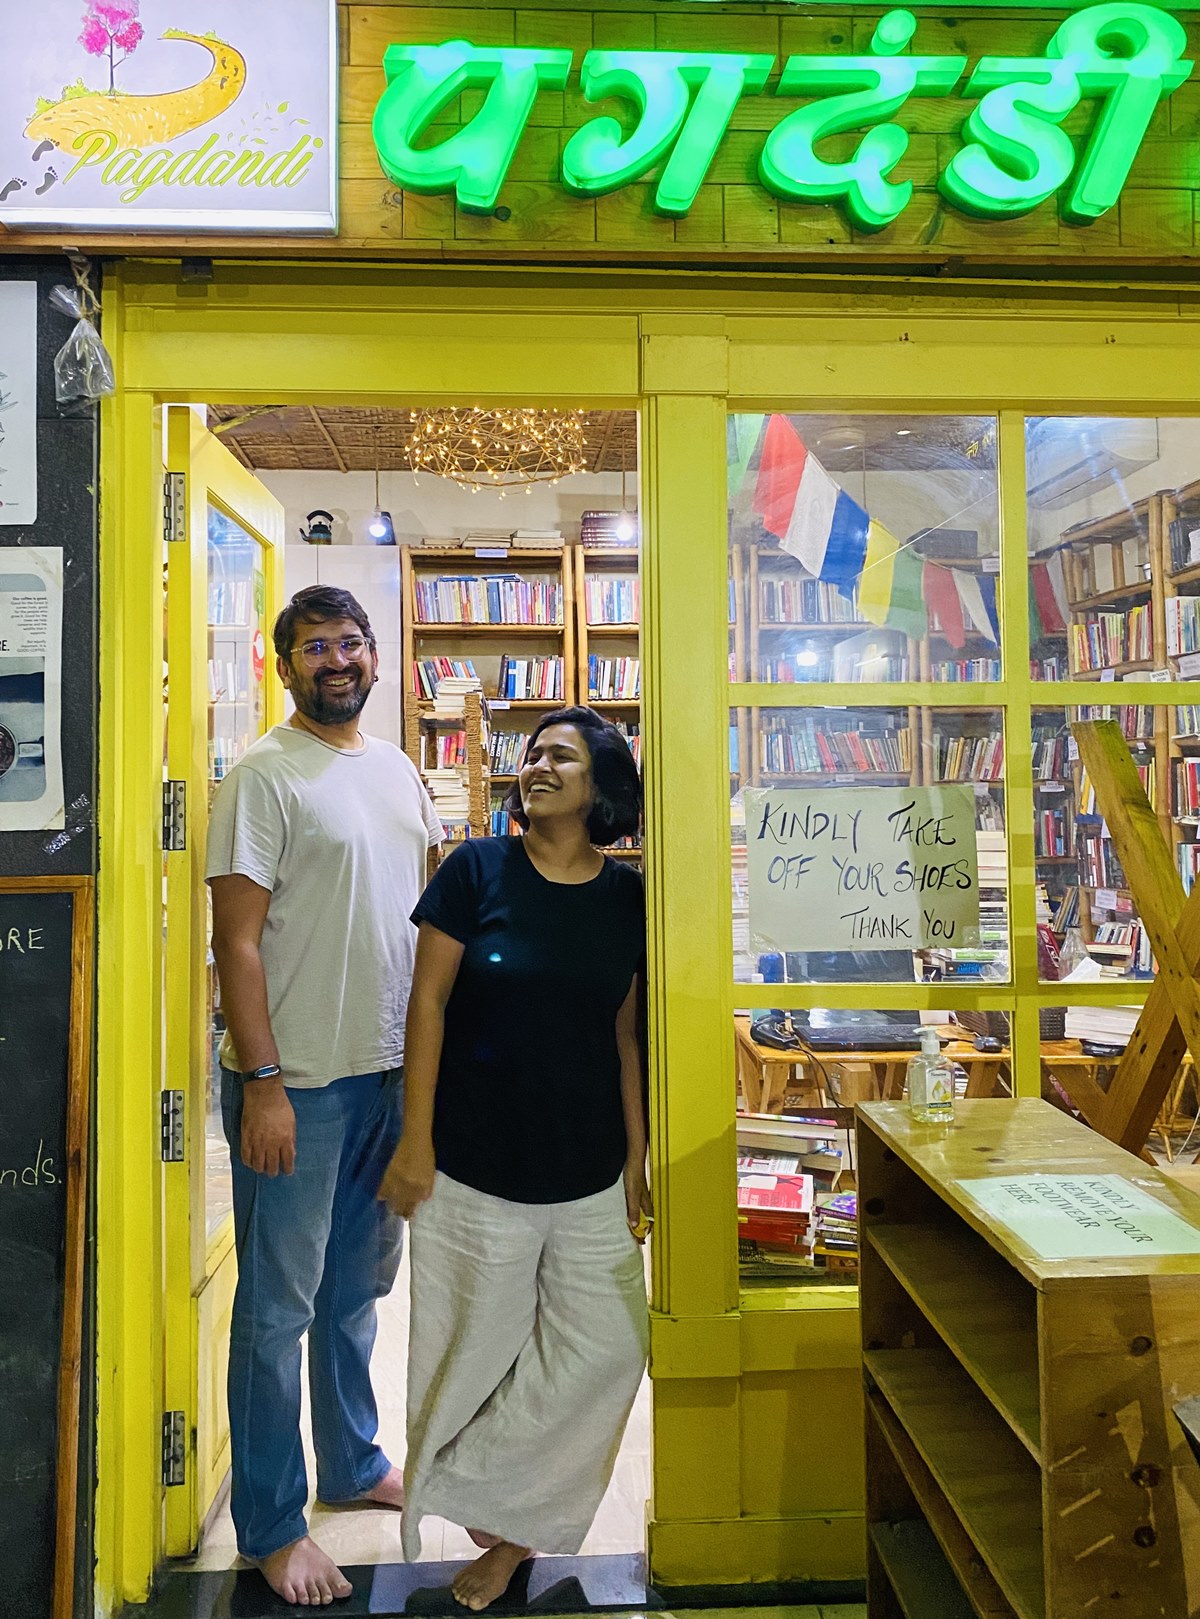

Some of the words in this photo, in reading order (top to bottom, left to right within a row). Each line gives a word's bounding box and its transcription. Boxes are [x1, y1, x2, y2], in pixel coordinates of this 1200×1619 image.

[371, 1, 1196, 234] पगदंडी
[63, 129, 324, 204] Pagdandi
[757, 802, 862, 854] KINDLY
[888, 801, 956, 846] TAKE
[767, 854, 817, 890] OFF
[832, 855, 888, 897] YOUR
[893, 859, 972, 893] SHOES
[0, 927, 45, 953] RE
[840, 906, 912, 940] THANK
[923, 908, 955, 940] YOU
[1000, 1184, 1040, 1205] HERE
[1028, 1182, 1101, 1229] FOOTWEAR
[1056, 1181, 1116, 1216] REMOVE
[1105, 1216, 1153, 1243] YOUR
[1084, 1181, 1141, 1211] KINDLY
